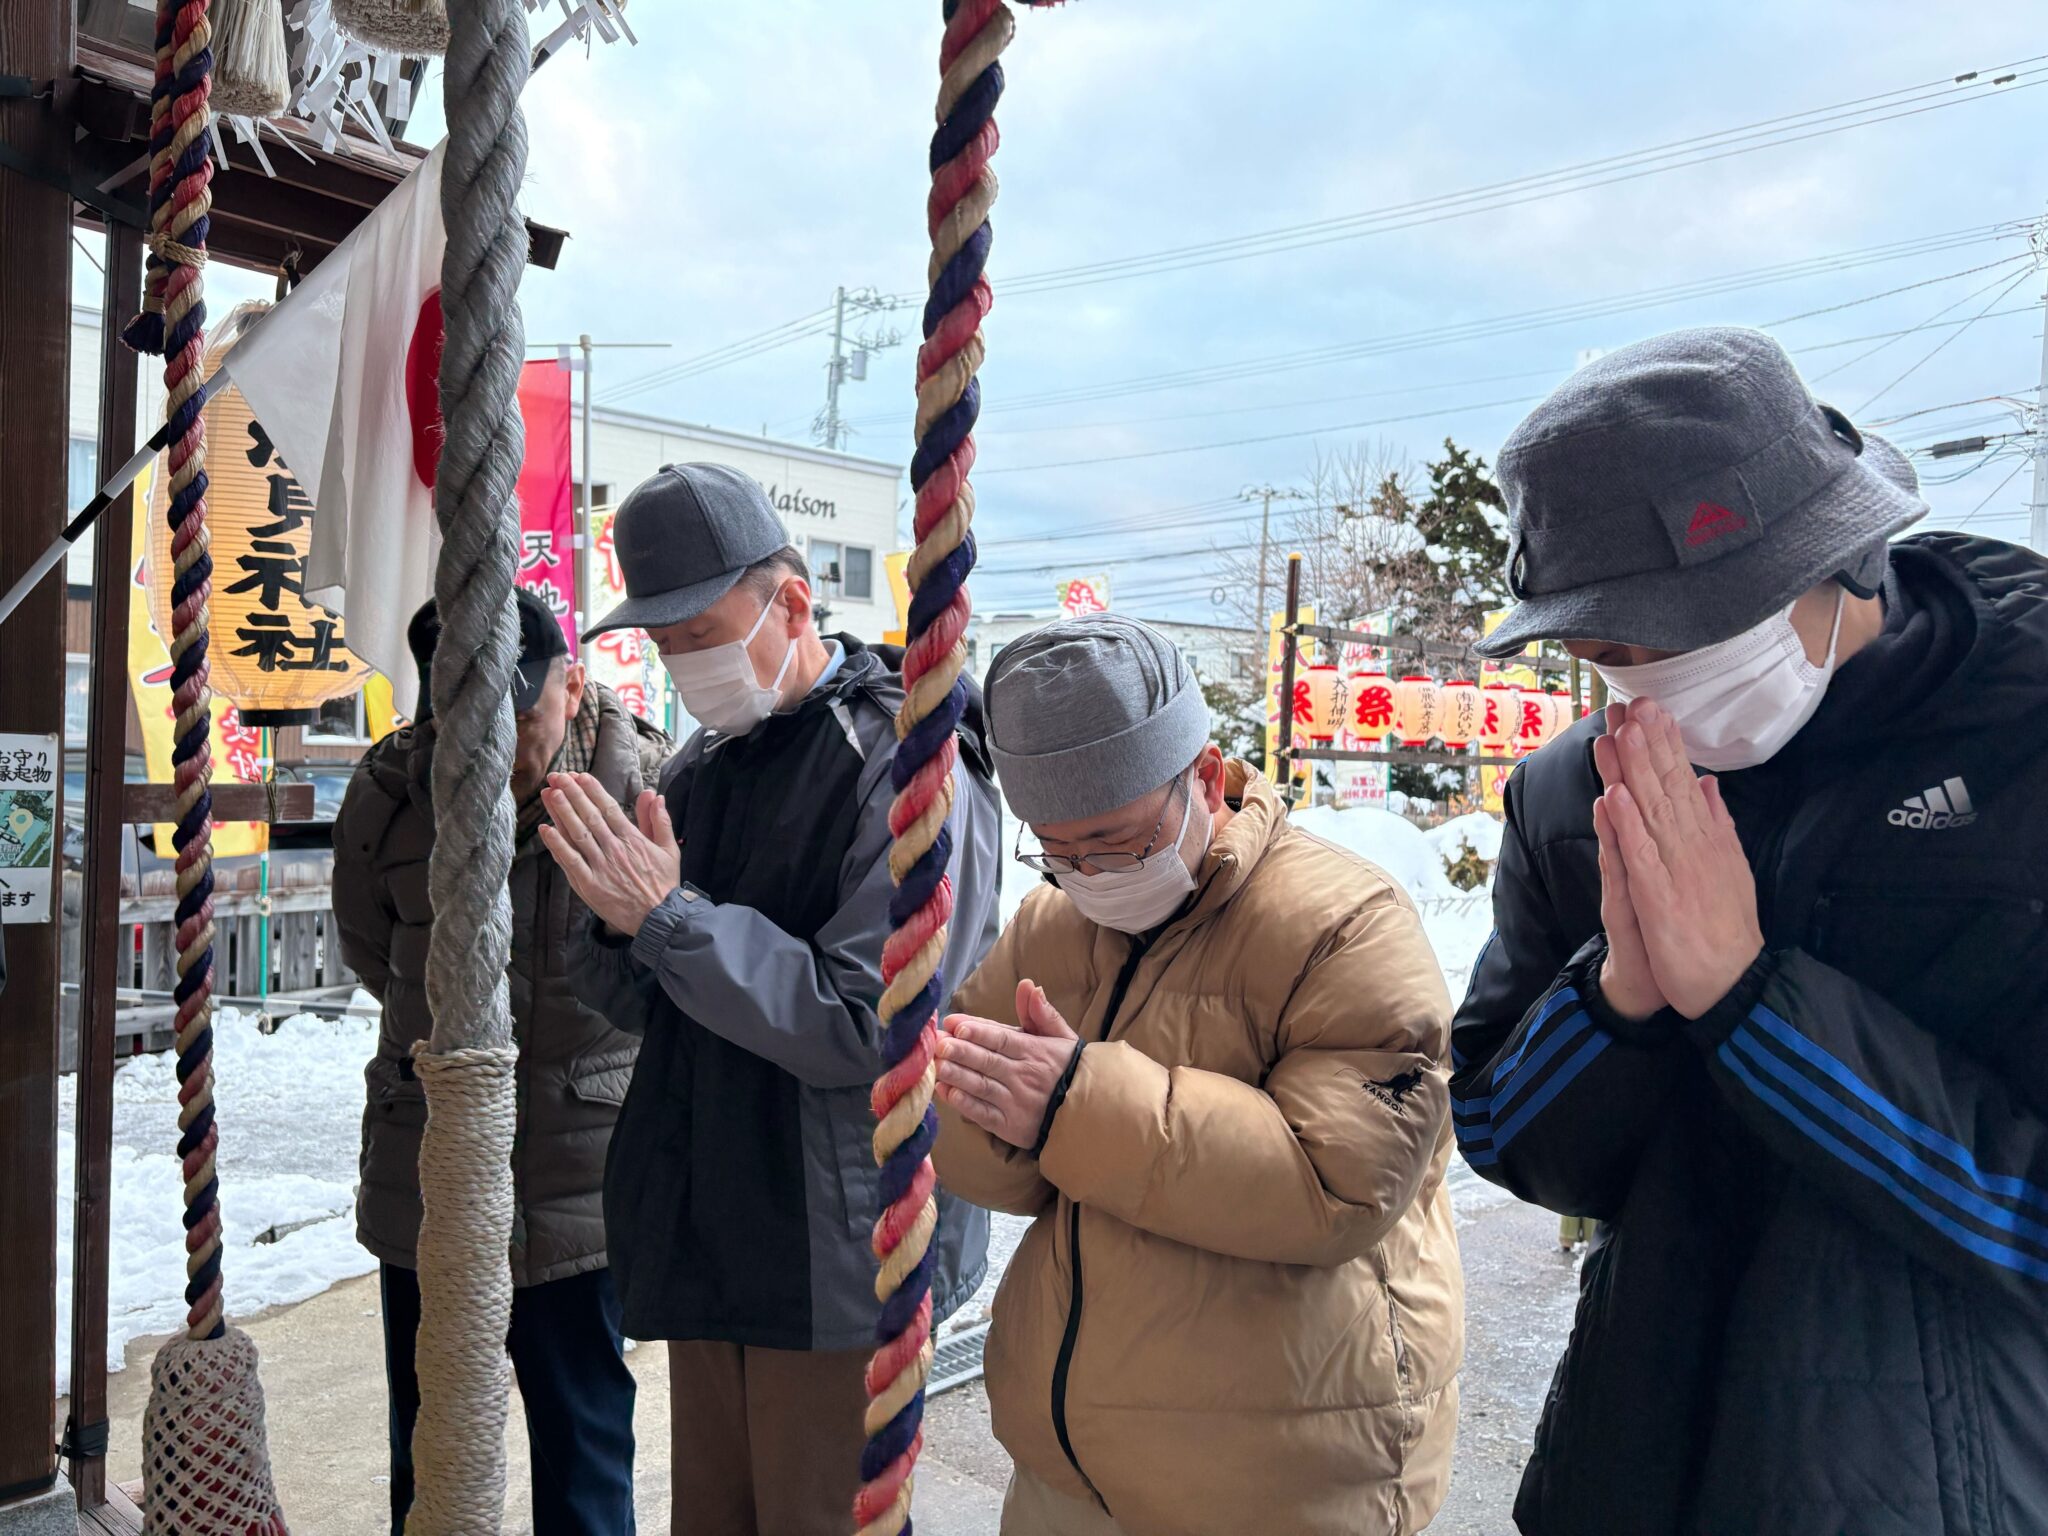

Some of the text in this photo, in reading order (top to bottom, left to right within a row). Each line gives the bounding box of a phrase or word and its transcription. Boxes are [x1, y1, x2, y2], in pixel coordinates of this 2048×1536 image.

[222, 419, 349, 672] 見神社
[1355, 685, 1394, 728] 祭
[1887, 808, 1978, 830] adidas
[1362, 1082, 1405, 1117] KANGOL
